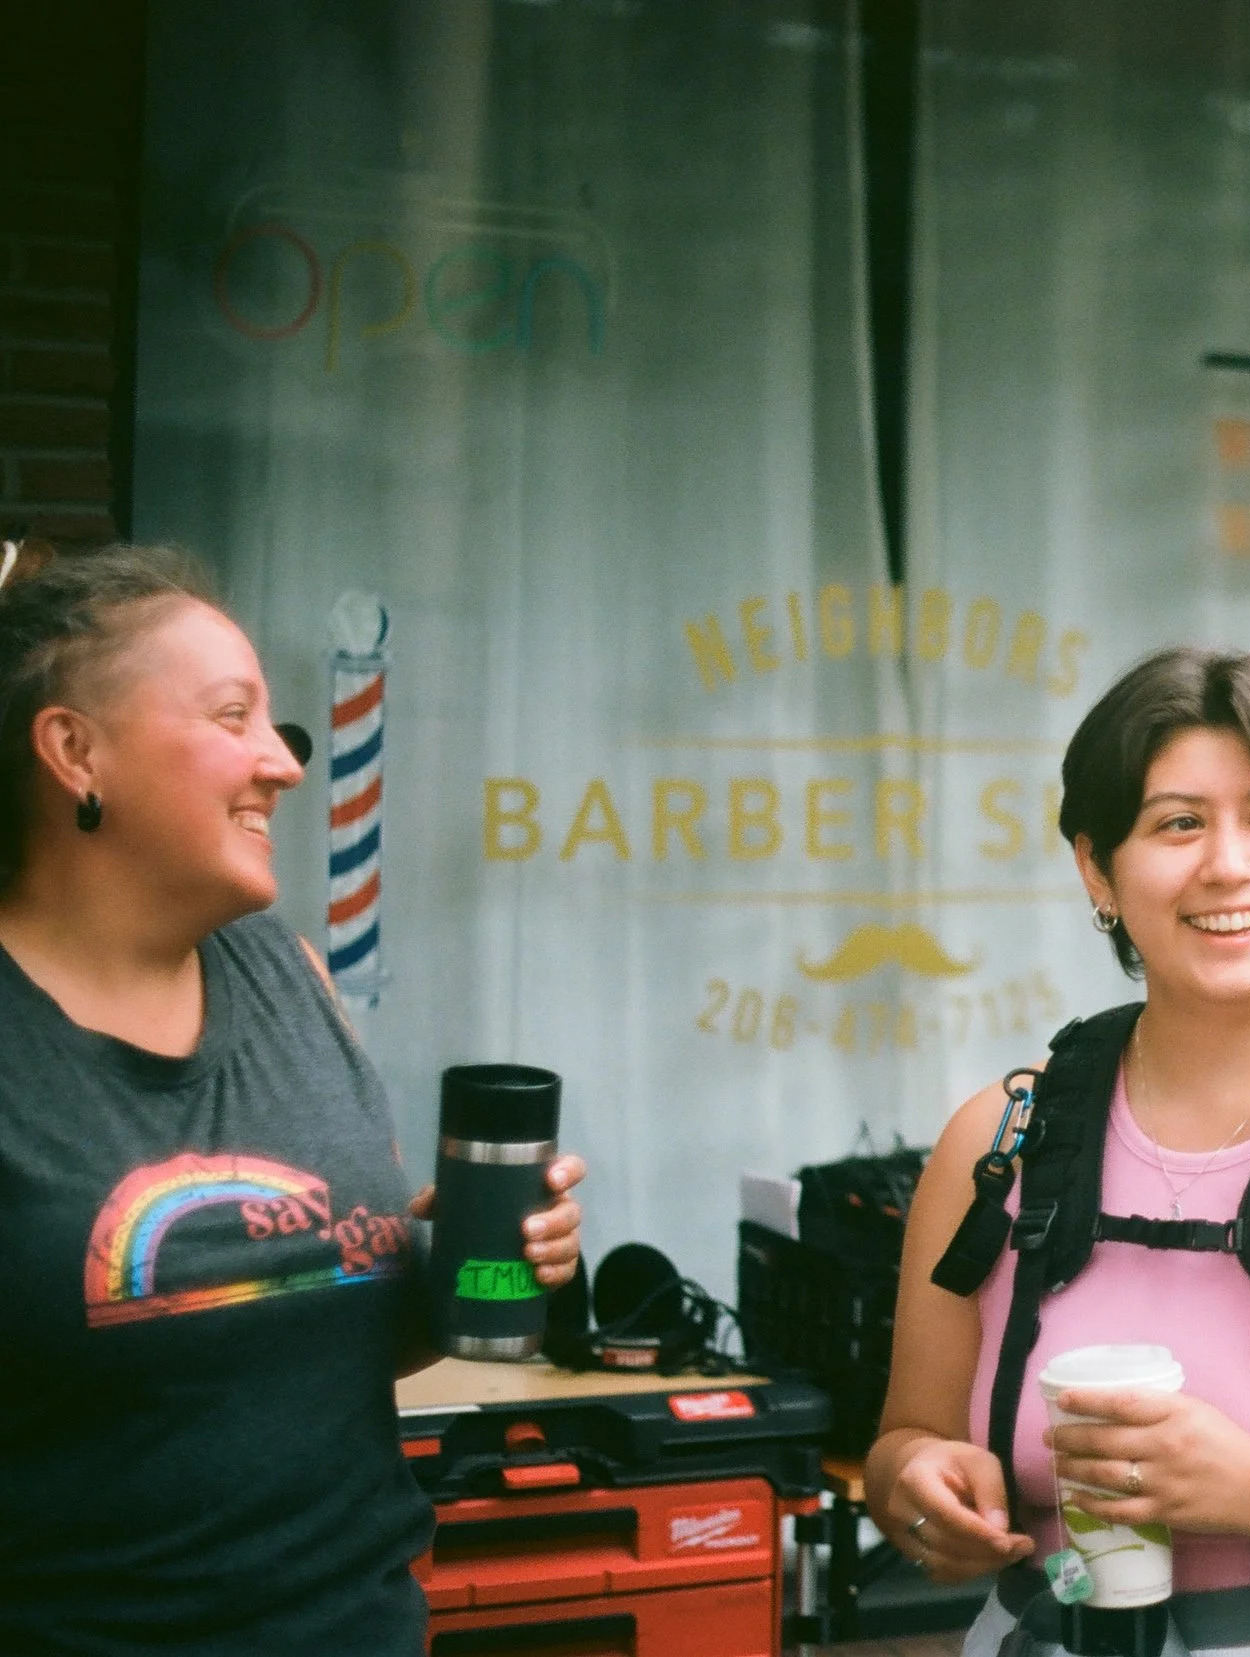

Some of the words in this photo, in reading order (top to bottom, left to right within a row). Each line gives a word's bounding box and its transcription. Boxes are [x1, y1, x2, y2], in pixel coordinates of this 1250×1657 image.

[213, 222, 606, 373] open
[684, 582, 1091, 697] NEIGHBORS
[482, 775, 929, 862] BARBER
[240, 1186, 332, 1242] say
